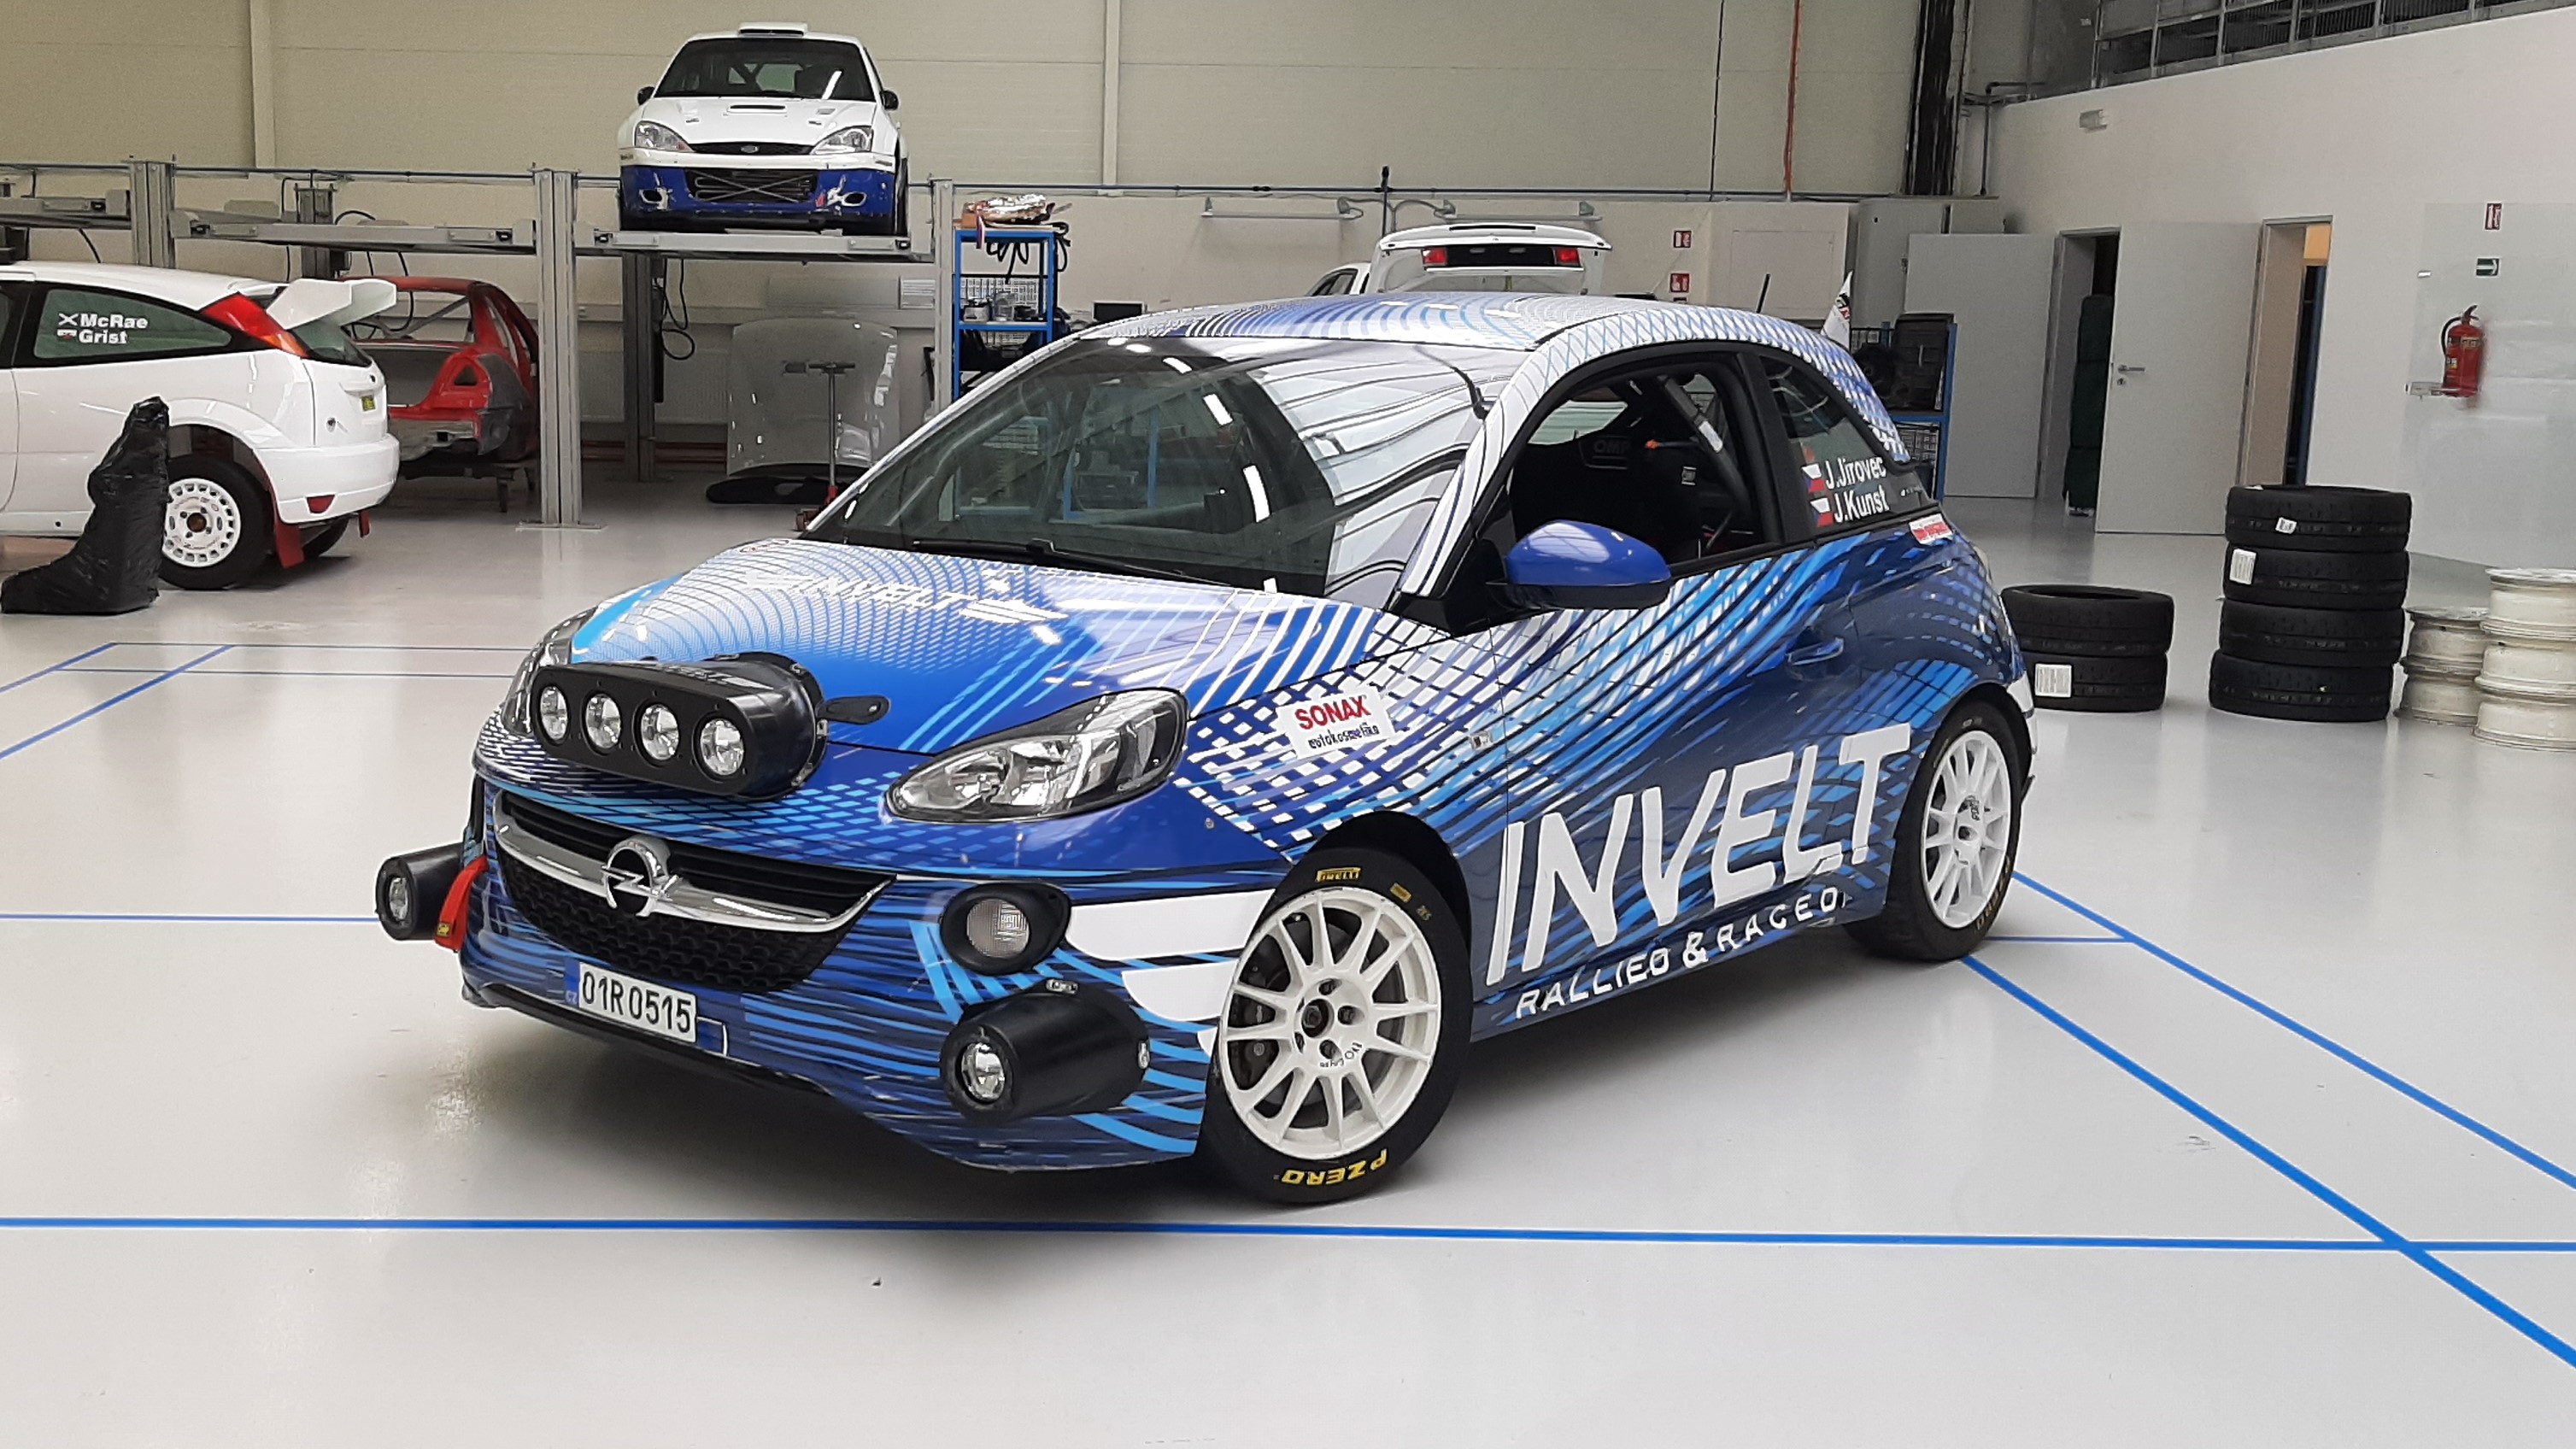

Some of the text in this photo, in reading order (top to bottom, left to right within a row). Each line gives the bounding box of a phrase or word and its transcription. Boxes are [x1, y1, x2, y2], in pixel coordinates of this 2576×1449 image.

[79, 313, 149, 329] McRae
[79, 328, 128, 344] Grist
[1834, 484, 1890, 523] J.Kunst
[1294, 695, 1371, 730] SONAX
[1485, 723, 1911, 986] INVELT
[1316, 866, 1361, 883] PIRELLI
[1682, 931, 1709, 969] &
[582, 971, 691, 1033] 01R0515
